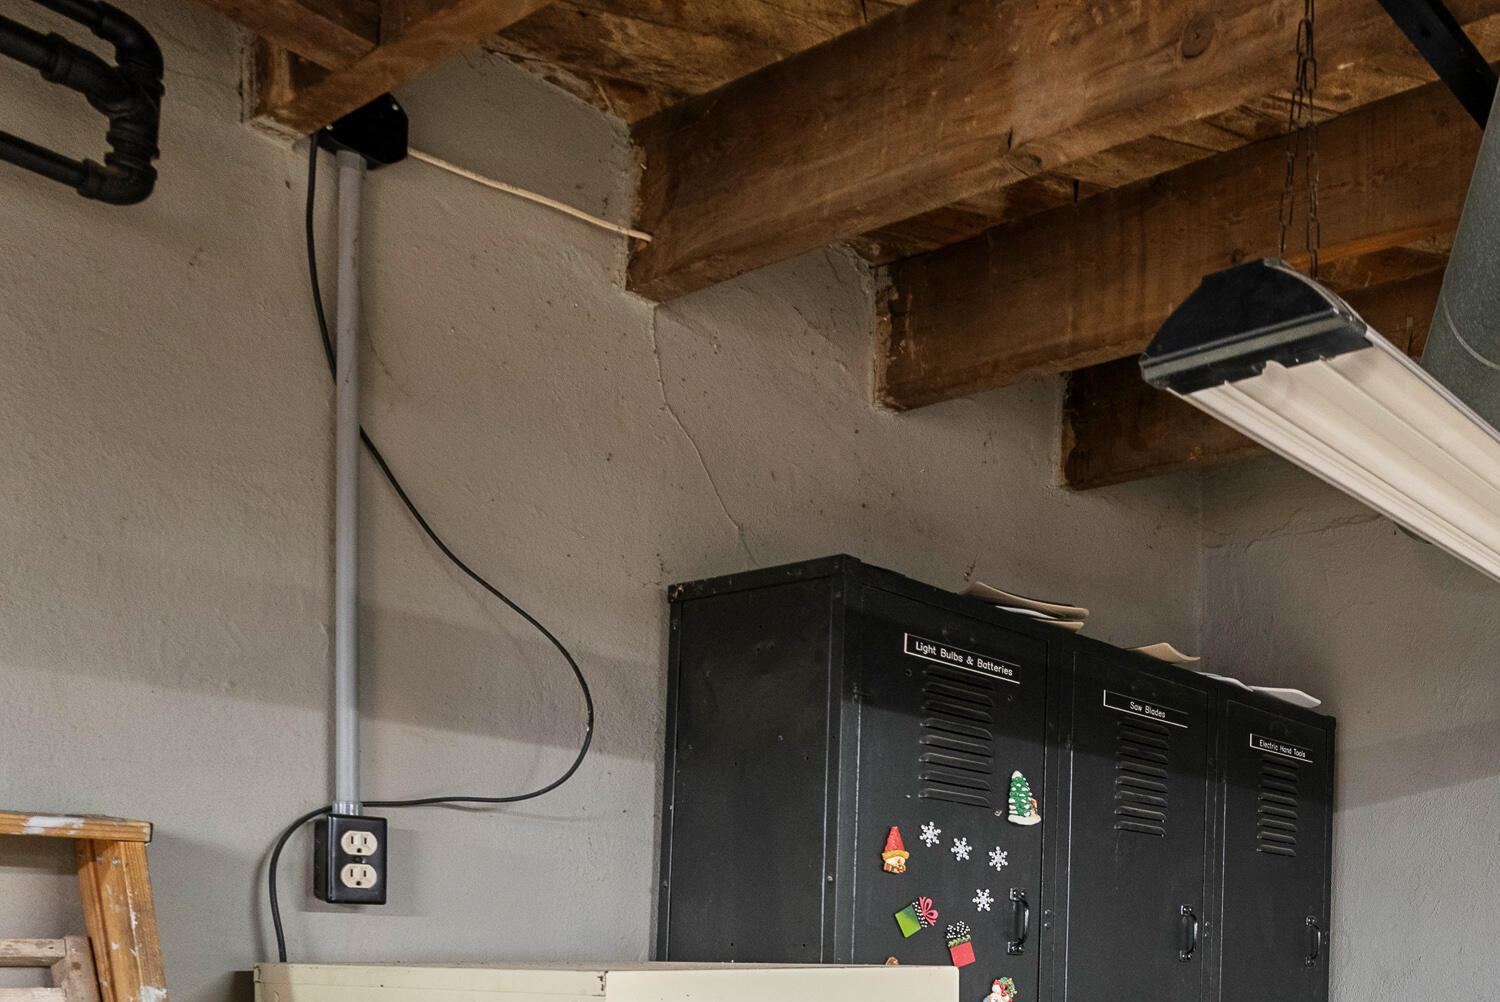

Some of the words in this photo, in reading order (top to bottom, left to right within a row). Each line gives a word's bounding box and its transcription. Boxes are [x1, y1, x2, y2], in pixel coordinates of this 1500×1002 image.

[915, 641, 937, 656] Light
[940, 648, 963, 663] Bulbs
[966, 656, 974, 666] &
[977, 658, 1013, 676] Batteries
[1129, 701, 1142, 712] Saw
[1144, 705, 1166, 718] Blades
[1259, 739, 1278, 751] Electric
[1279, 744, 1292, 755] Hand
[1293, 747, 1306, 758] Tools
